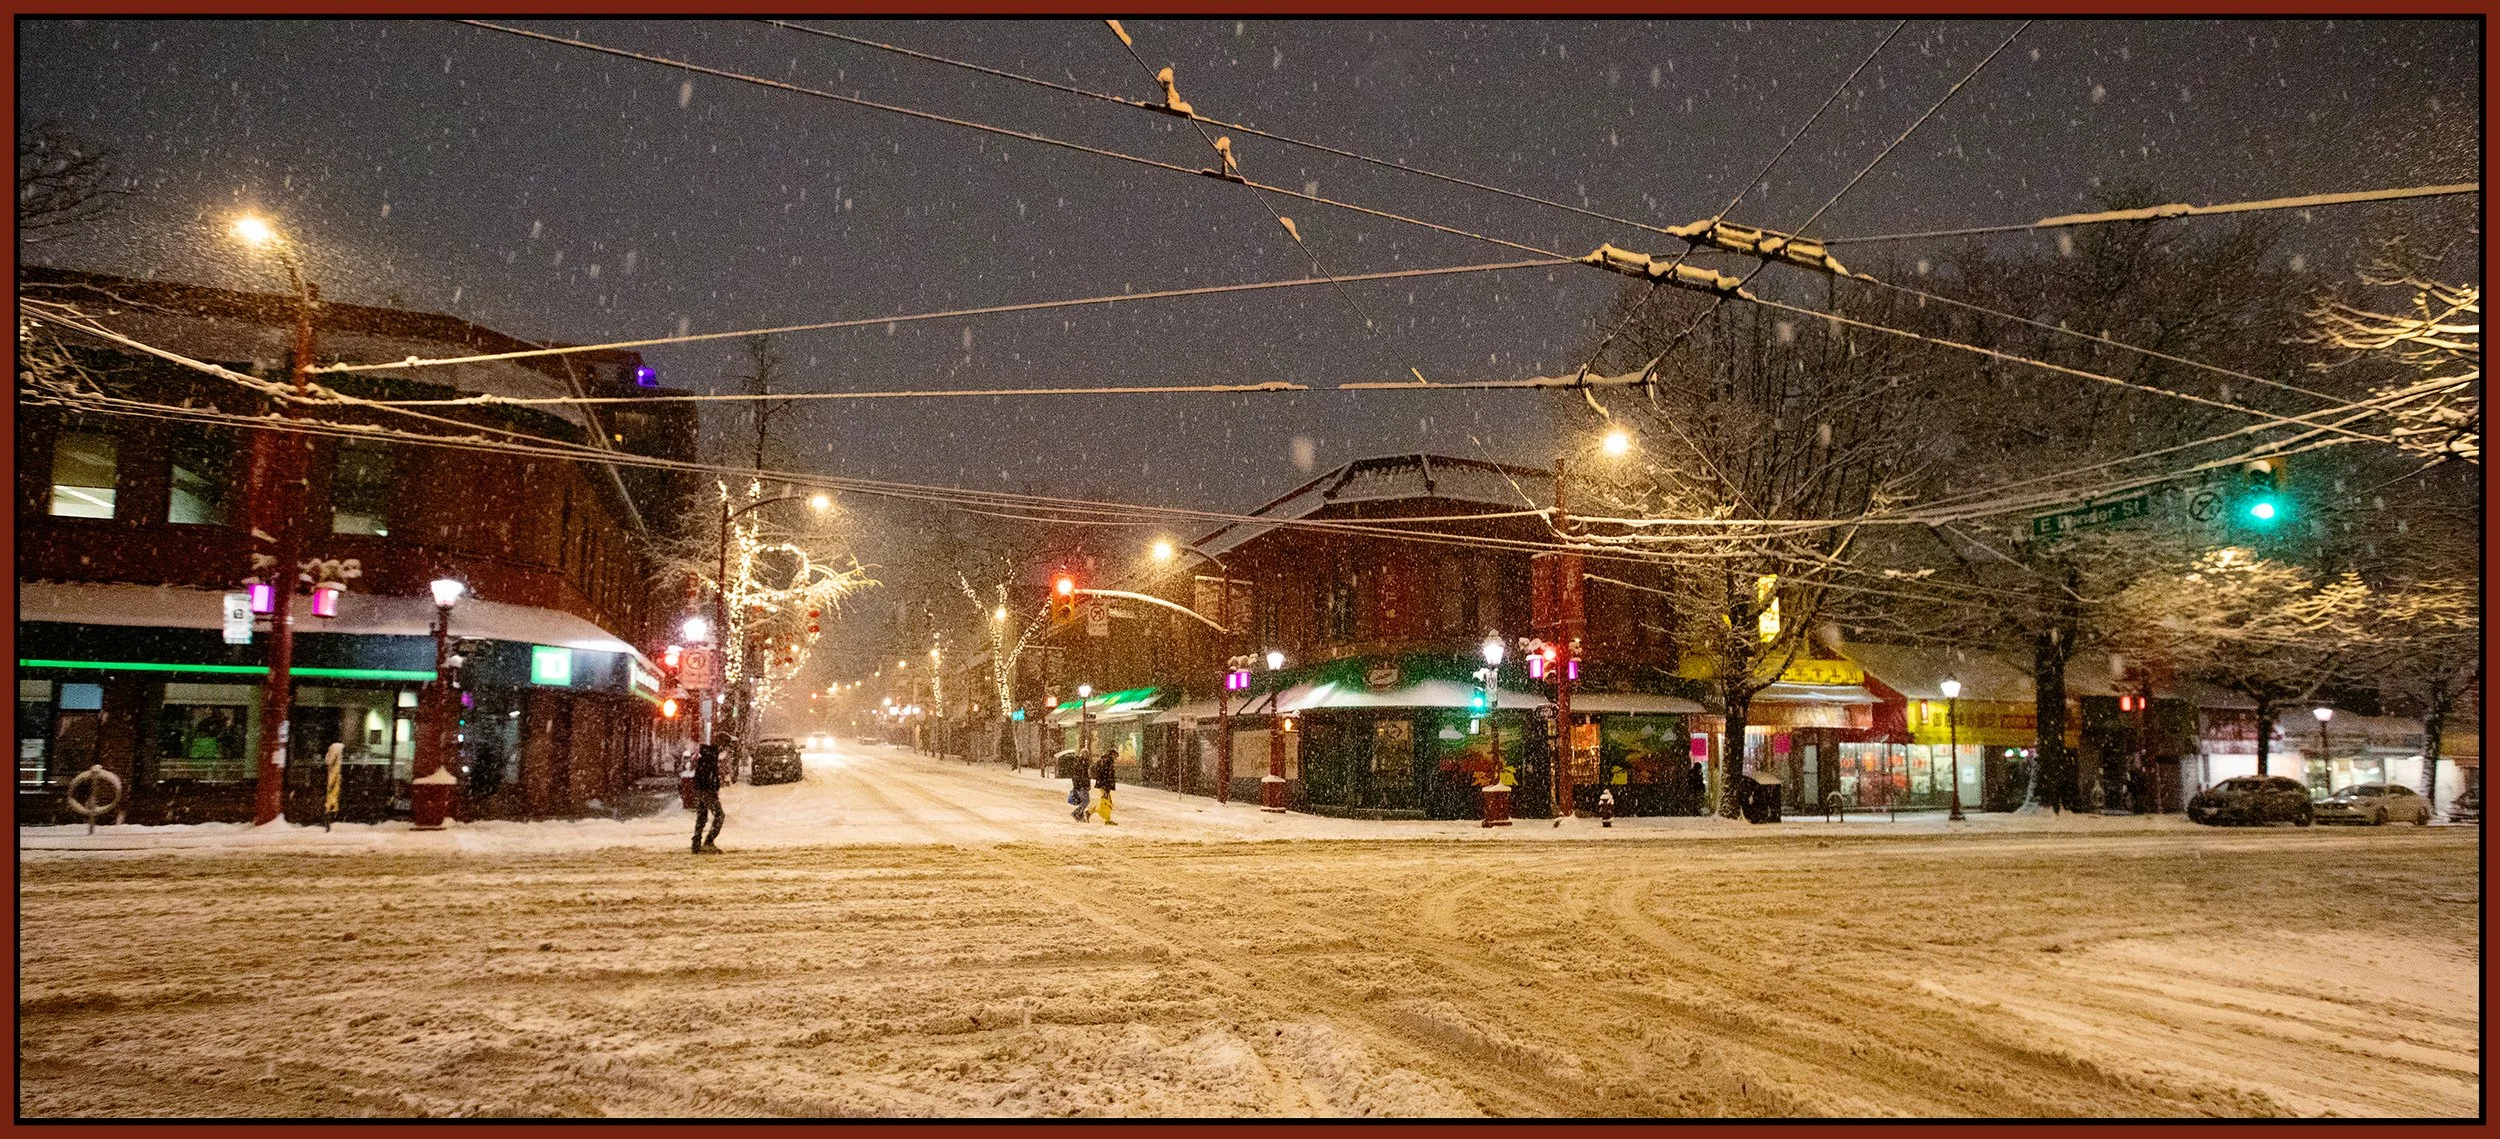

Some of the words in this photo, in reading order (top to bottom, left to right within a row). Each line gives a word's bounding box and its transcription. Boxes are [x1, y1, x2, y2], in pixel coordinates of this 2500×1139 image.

[2040, 516, 2051, 533] E
[2121, 500, 2140, 516] St
[536, 652, 569, 678] TD
